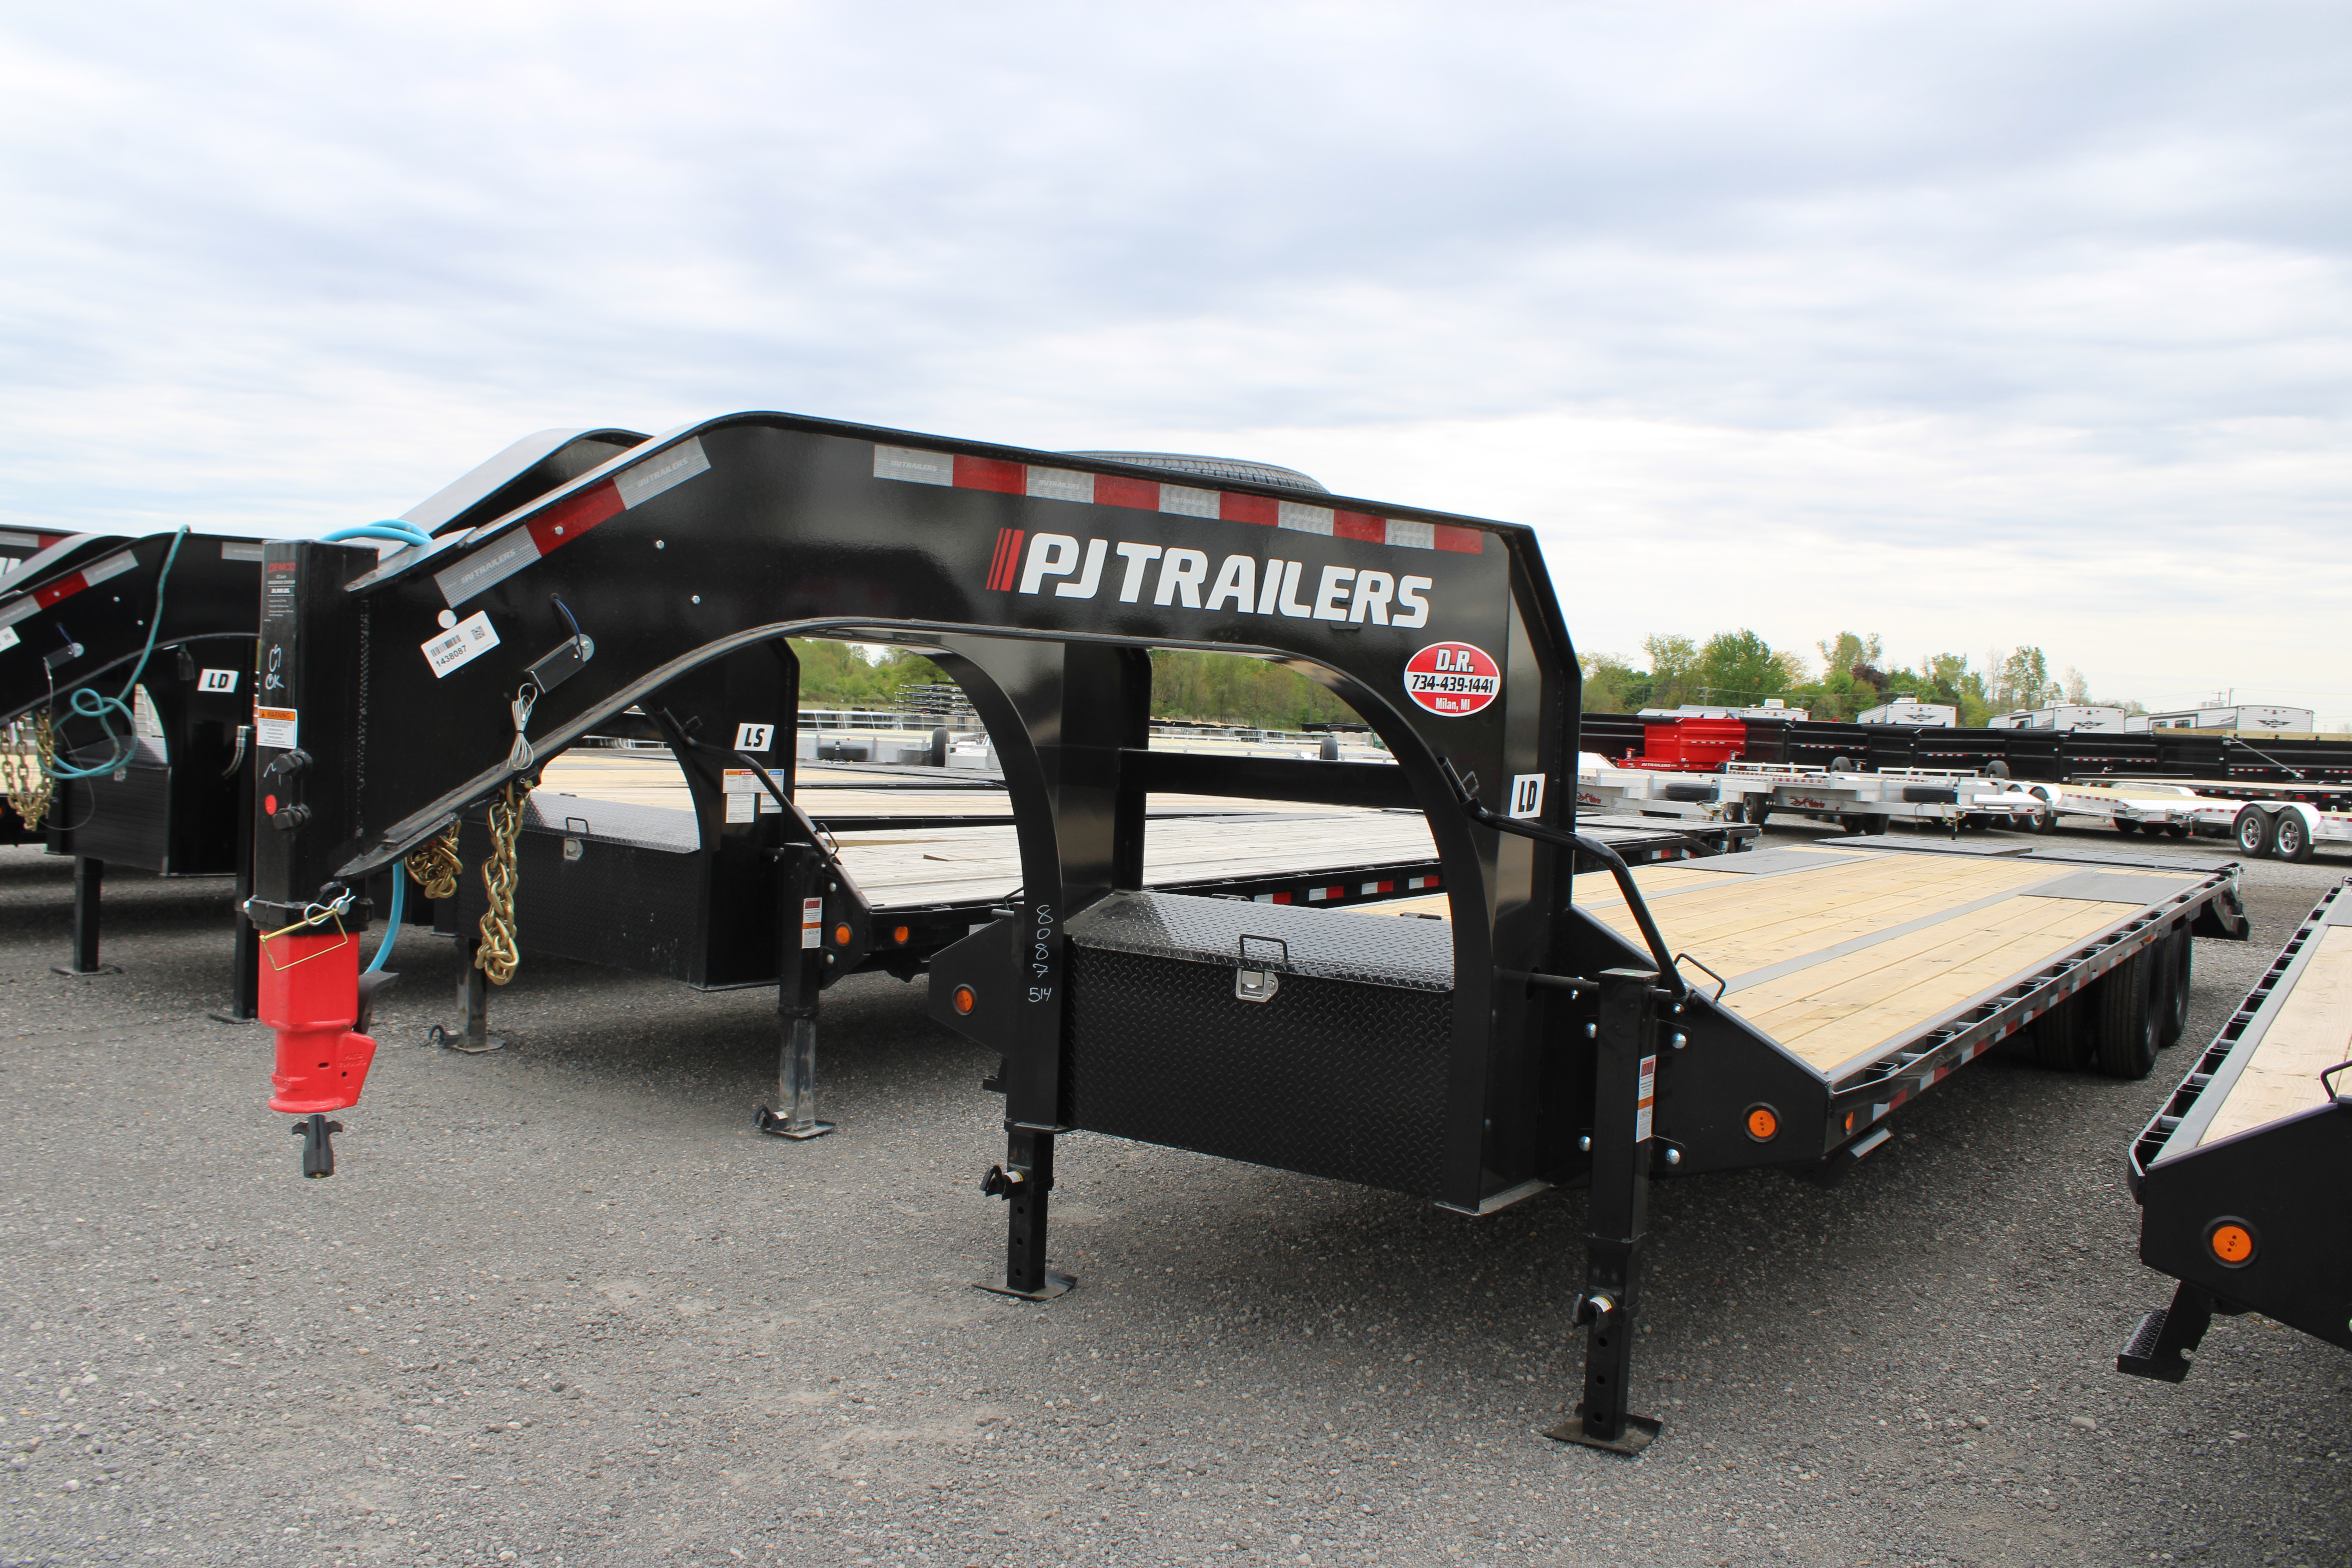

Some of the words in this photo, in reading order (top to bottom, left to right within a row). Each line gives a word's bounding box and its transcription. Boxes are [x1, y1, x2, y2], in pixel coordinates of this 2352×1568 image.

[902, 461, 937, 471] TRAILERS
[268, 562, 296, 573] DEMCO
[1019, 532, 1108, 599] PJ
[1116, 541, 1433, 628] TRAILERS
[436, 644, 468, 668] 1438087
[1435, 648, 1474, 673] D.R.
[208, 673, 230, 689] LD
[1412, 675, 1494, 693] 734-439-1441
[1435, 697, 1459, 712] Milan,
[1461, 699, 1470, 711] MI
[267, 711, 290, 719] WARNING
[743, 727, 765, 747] LS
[1517, 780, 1538, 813] LD
[1028, 987, 1052, 1003] 514
